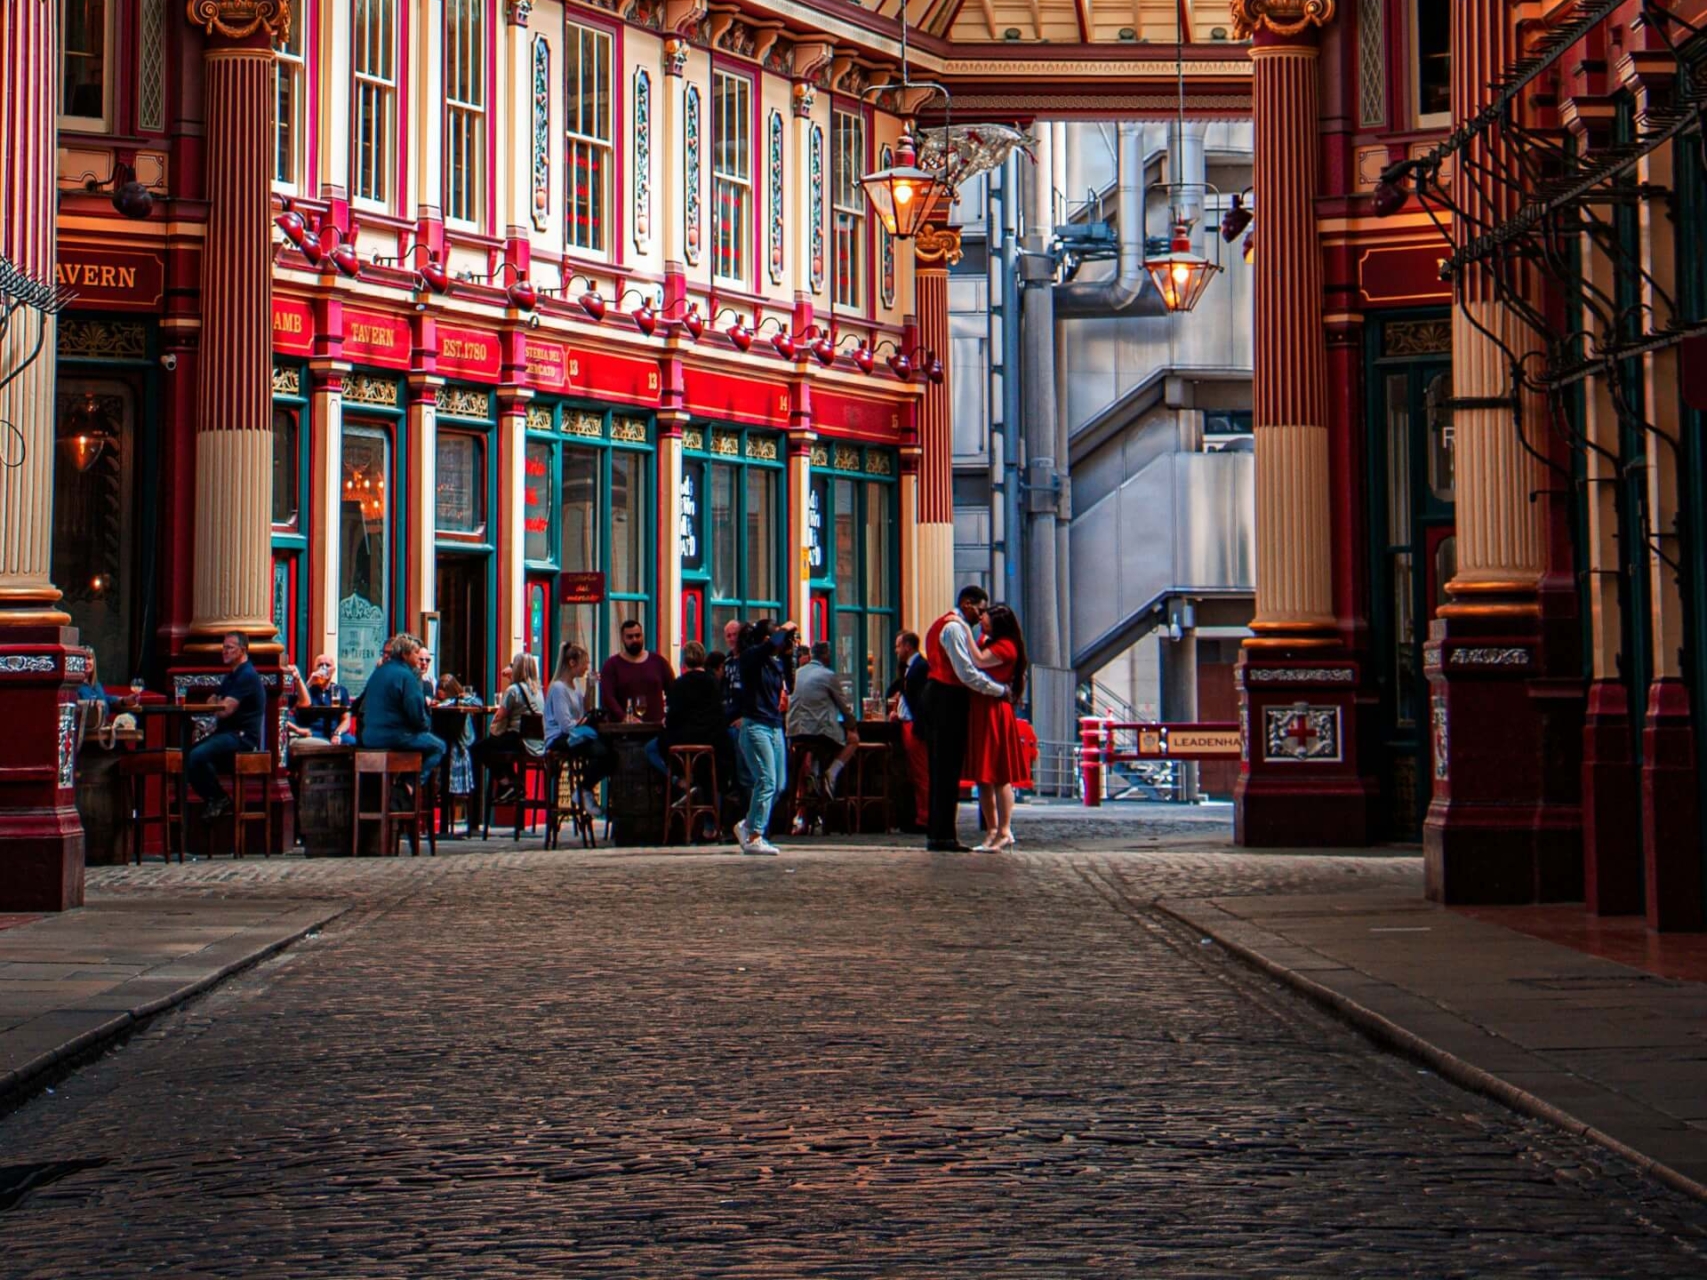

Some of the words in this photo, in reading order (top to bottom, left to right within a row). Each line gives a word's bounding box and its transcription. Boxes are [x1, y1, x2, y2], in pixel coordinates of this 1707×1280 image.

[55, 263, 136, 288] AVERN
[273, 311, 303, 333] AMB
[351, 322, 395, 347] TAVERN
[525, 346, 549, 360] STERIA
[525, 362, 556, 378] ERCATO
[648, 372, 658, 390] 13
[779, 395, 788, 412] 14
[1173, 737, 1241, 747] LEADENHA
